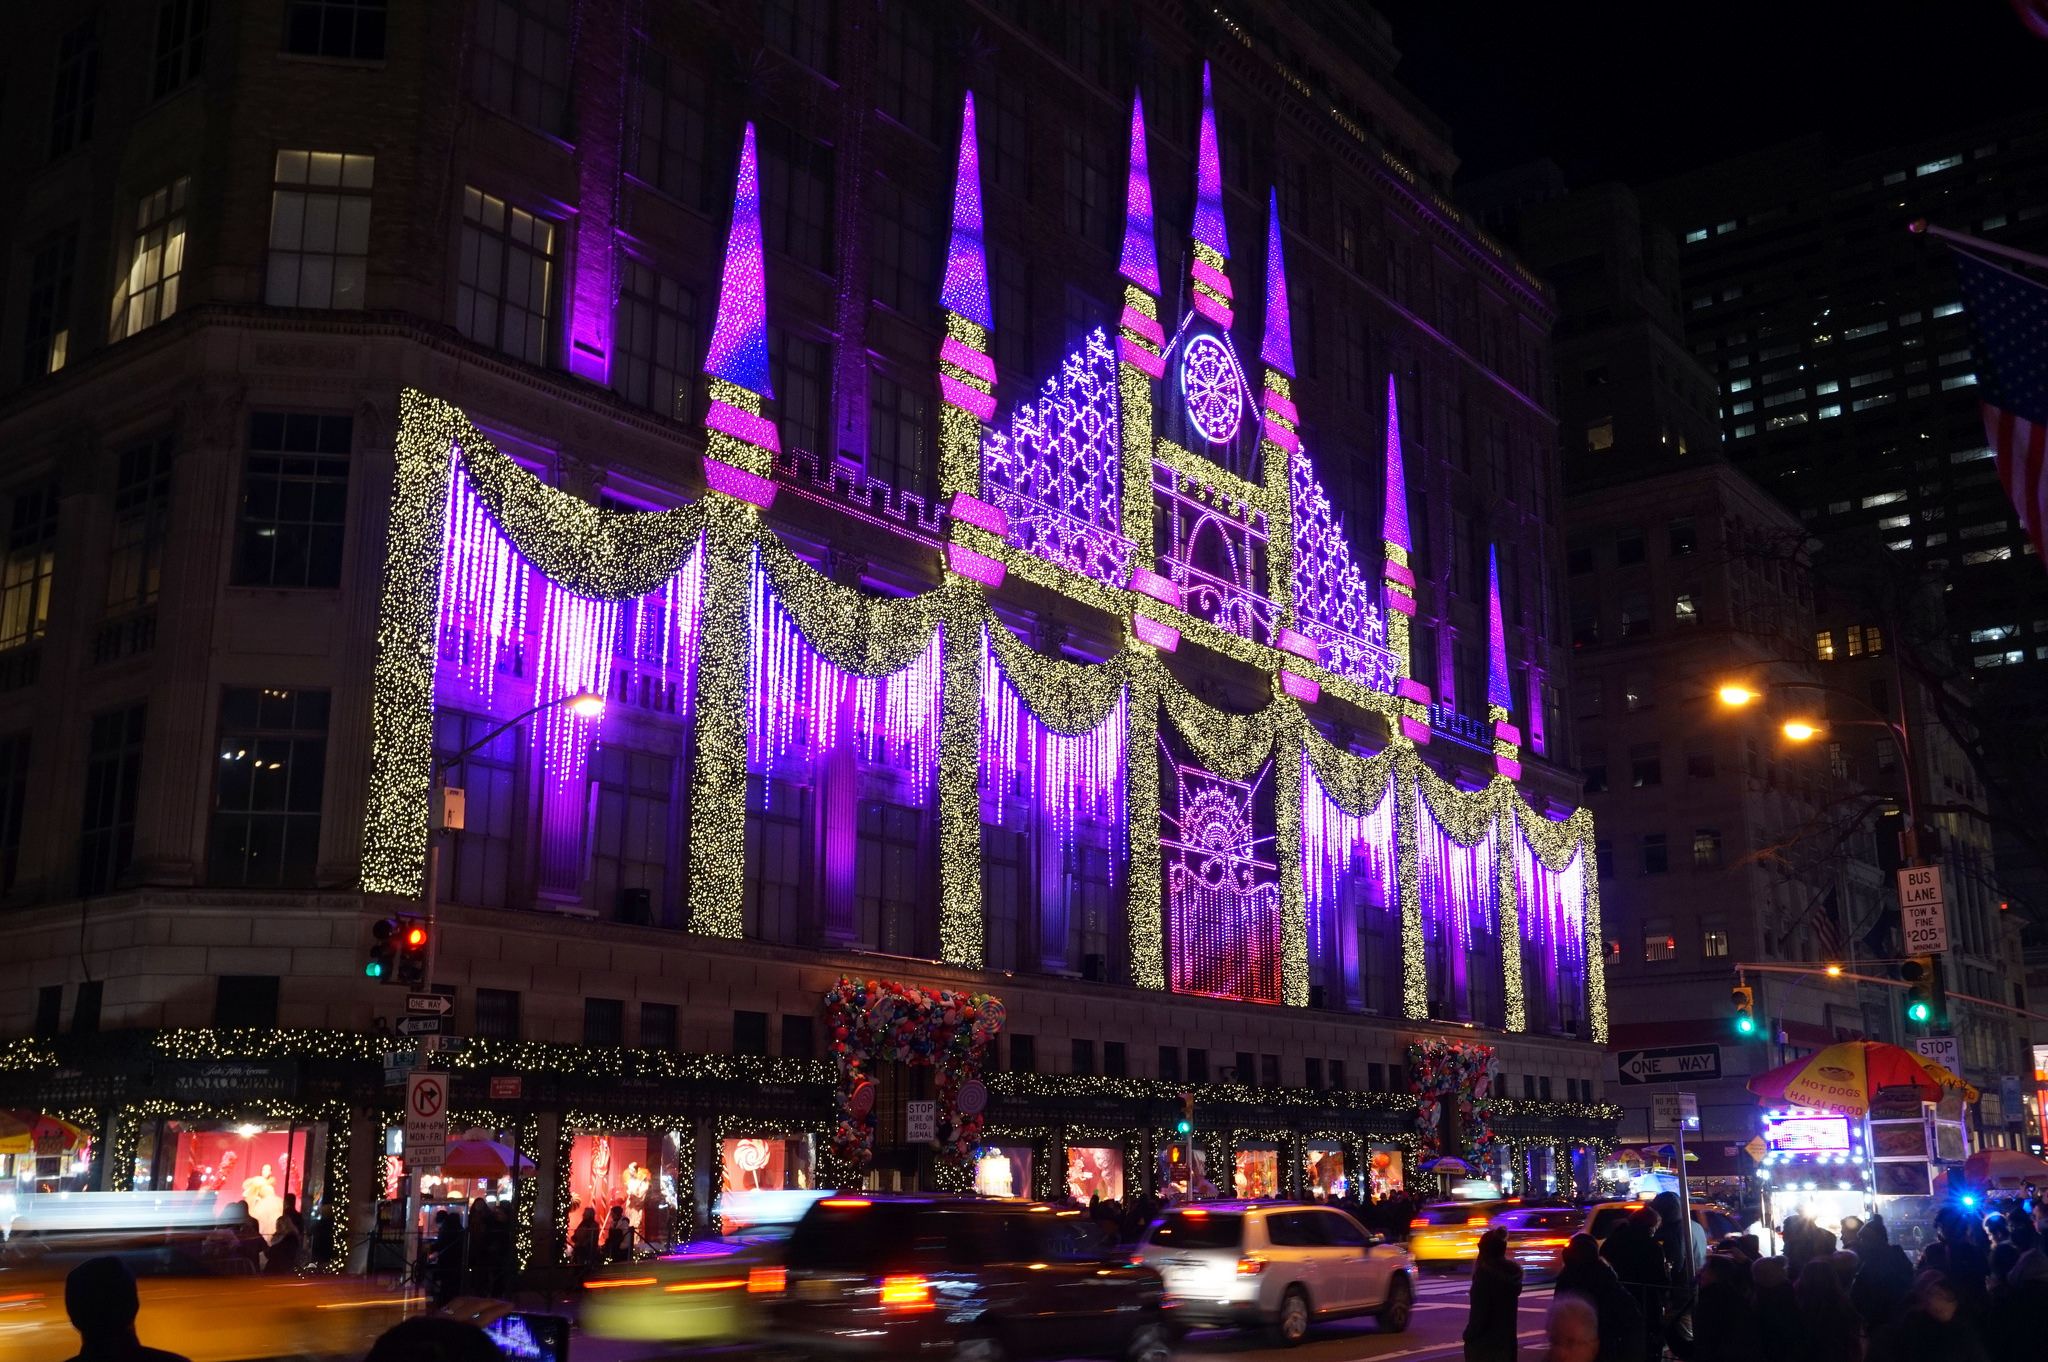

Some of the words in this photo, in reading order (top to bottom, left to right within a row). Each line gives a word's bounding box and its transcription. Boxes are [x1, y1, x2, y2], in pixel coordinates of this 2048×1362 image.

[1908, 872, 1931, 885] BUS
[1907, 887, 1936, 902] LANE
[1910, 908, 1927, 917] TOW
[1931, 906, 1938, 915] &
[1915, 917, 1934, 927] FINE
[411, 999, 425, 1008] ONE
[427, 1000, 441, 1009] WAY
[408, 1022, 420, 1031] ONE
[423, 1021, 437, 1029] WAY
[441, 1037, 449, 1050] 5
[1921, 1041, 1953, 1055] STOP
[1631, 1059, 1661, 1074] ONE
[1678, 1055, 1710, 1071] WAY
[1801, 1078, 1826, 1091] HOT
[1828, 1086, 1861, 1098] DOGS
[909, 1103, 933, 1113] STOP
[1830, 1103, 1863, 1116] FOOD
[408, 1121, 444, 1130] 10AM-6PM
[409, 1133, 442, 1141] MON-FRI
